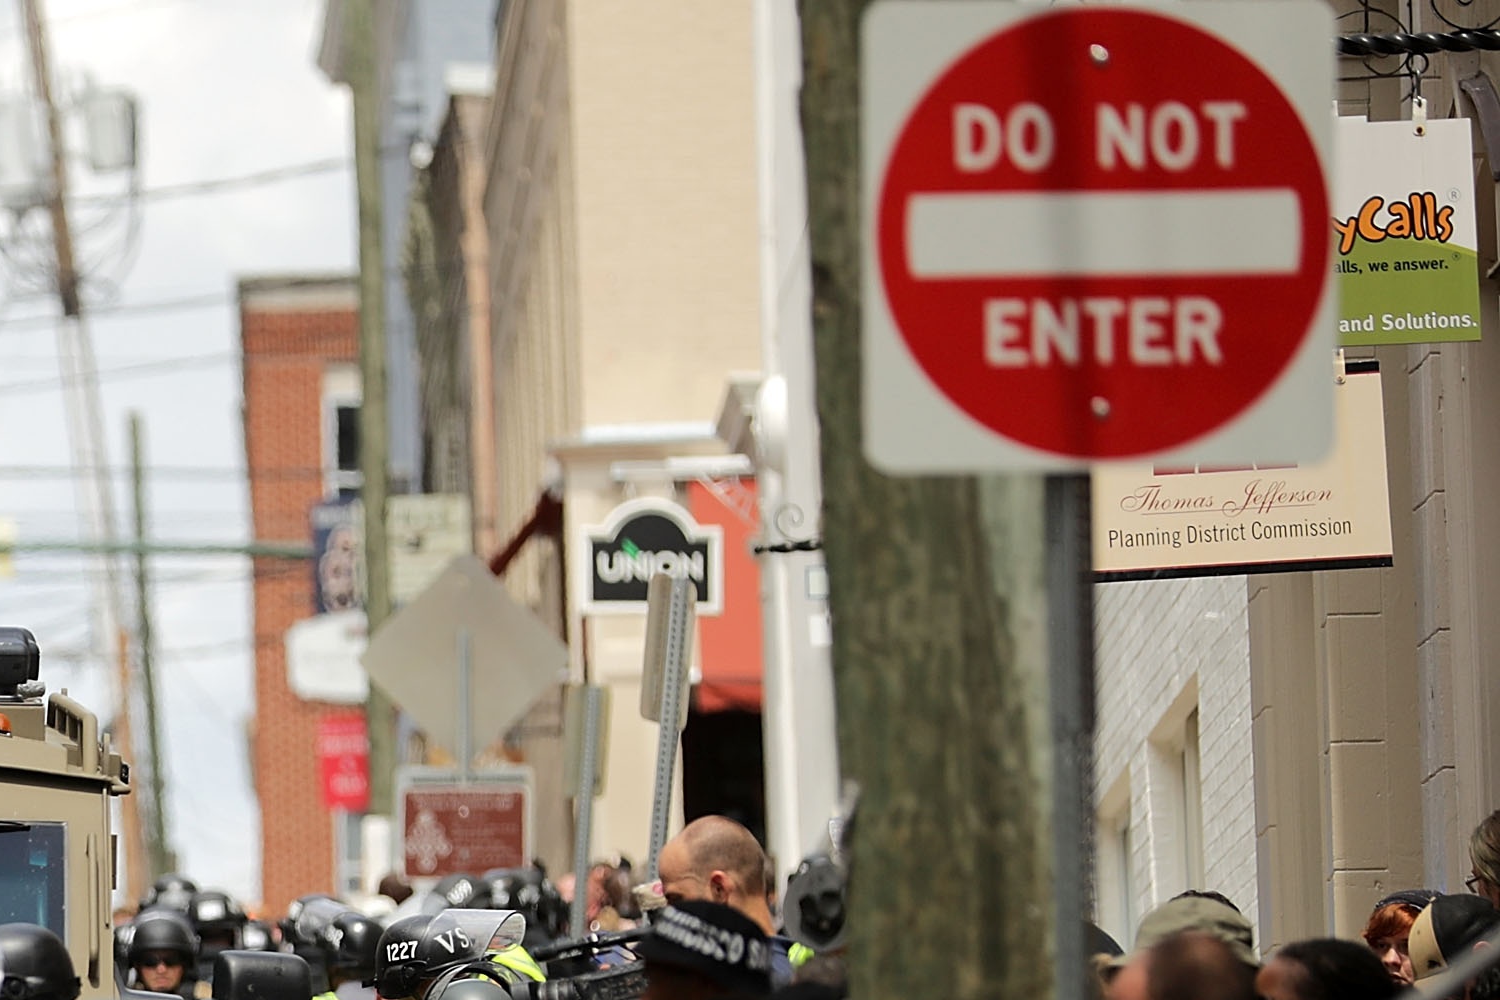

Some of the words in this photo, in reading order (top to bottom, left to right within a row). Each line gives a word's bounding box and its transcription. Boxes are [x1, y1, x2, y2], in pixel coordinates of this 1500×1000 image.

[953, 102, 1056, 173] DO
[1095, 101, 1247, 172] NOT
[1331, 192, 1454, 255] yCalls
[1334, 259, 1363, 274] alls,
[1368, 263, 1389, 273] we
[1394, 259, 1449, 272] answer.
[984, 297, 1223, 368] ENTER
[1339, 314, 1375, 332] and
[1381, 312, 1478, 331] Solutions.
[1120, 484, 1214, 513] Thomas
[1221, 479, 1332, 518] Jefferson
[1108, 528, 1182, 549] Planning
[1187, 522, 1246, 544] District
[1251, 518, 1352, 540] Commission
[596, 550, 704, 584] UNION
[386, 940, 418, 962] 1227
[433, 927, 476, 954] VS
